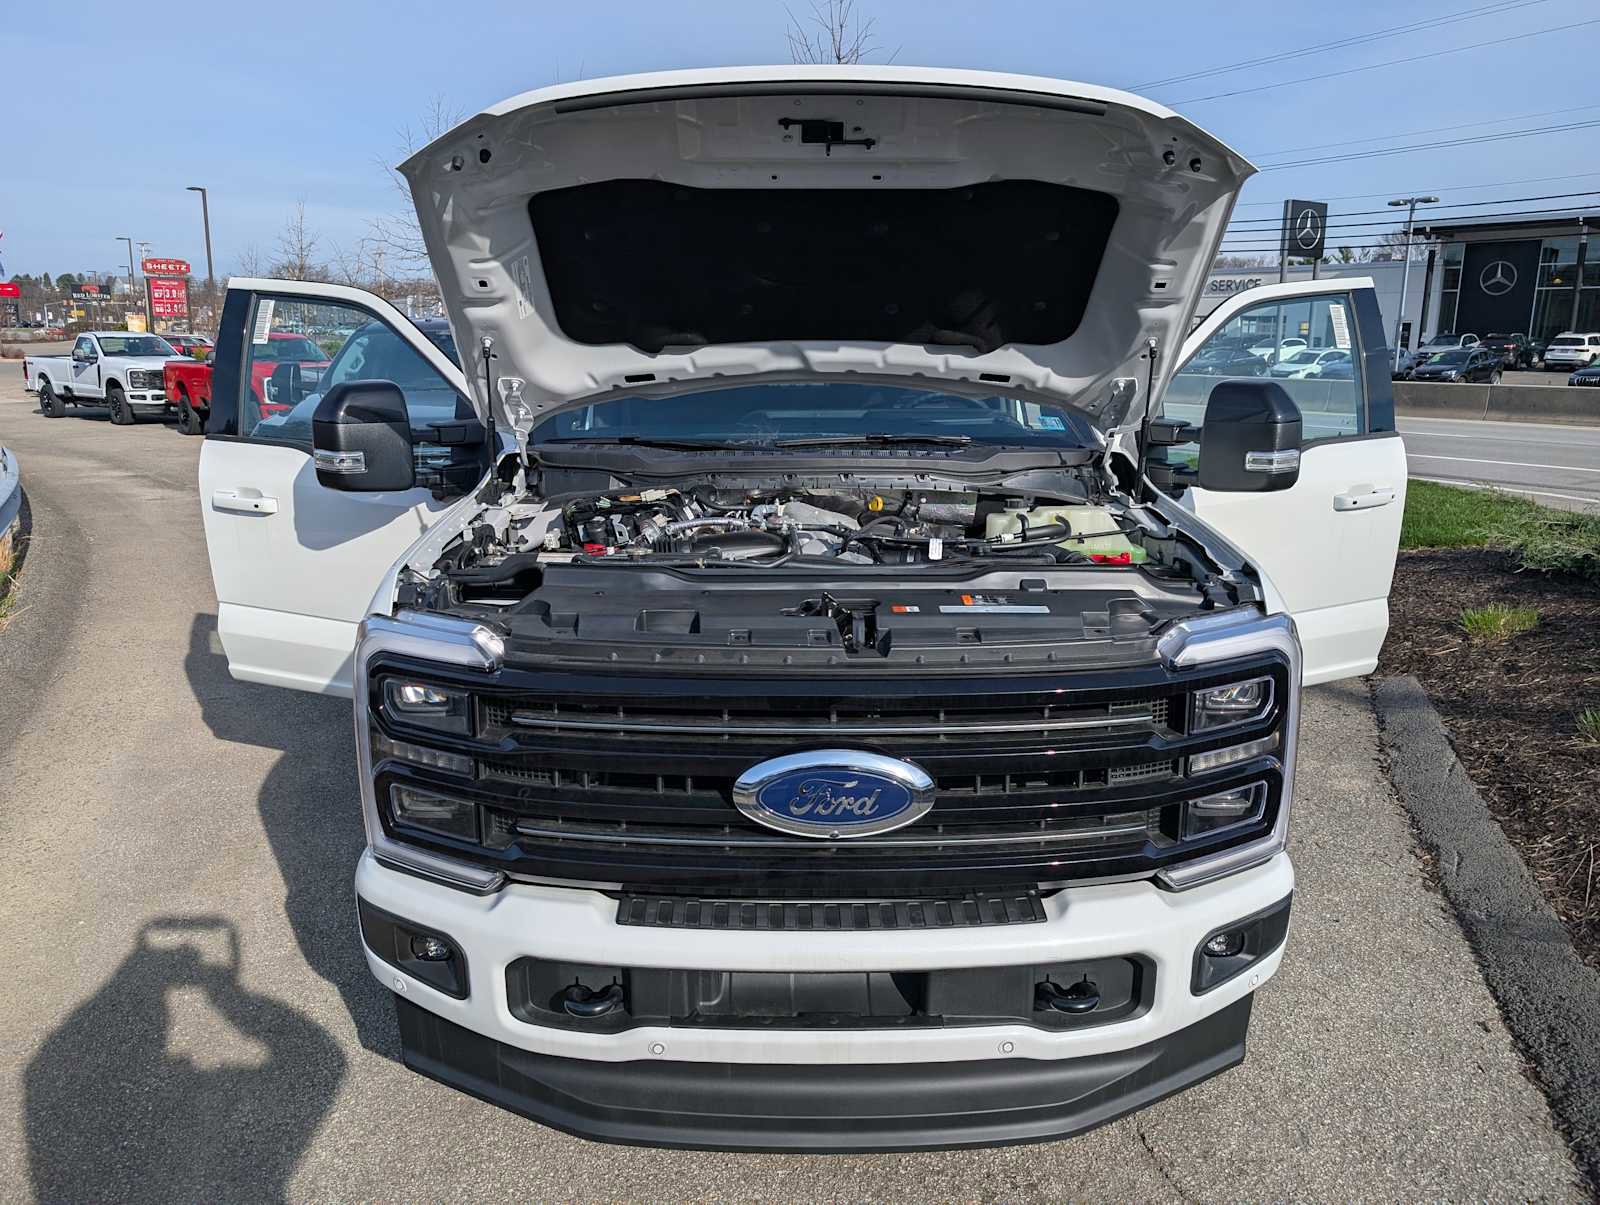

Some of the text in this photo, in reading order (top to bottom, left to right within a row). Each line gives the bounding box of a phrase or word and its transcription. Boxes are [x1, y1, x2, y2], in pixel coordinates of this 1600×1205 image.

[146, 262, 187, 271] SHEETZ
[1210, 278, 1262, 291] SERVICE
[789, 779, 882, 815] Ford
